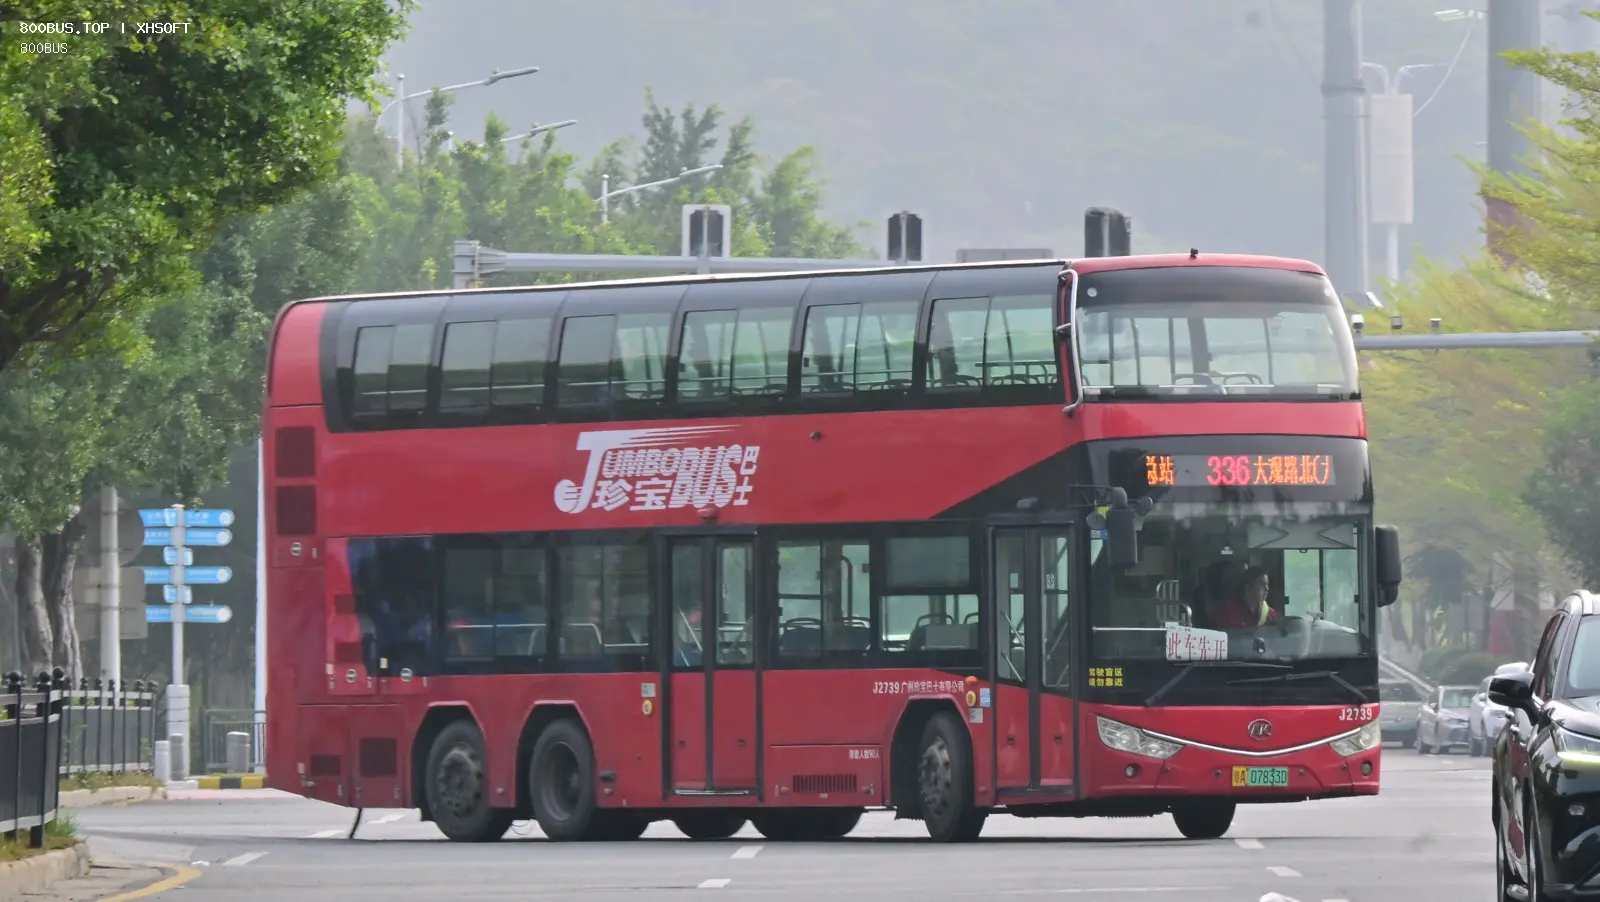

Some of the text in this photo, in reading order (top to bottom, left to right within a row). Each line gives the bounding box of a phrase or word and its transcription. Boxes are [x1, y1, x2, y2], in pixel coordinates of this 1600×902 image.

[1206, 455, 1250, 486] 336
[591, 477, 673, 511] 珍宝
[873, 680, 964, 694] J2739 广州珍宝巴士有限公司
[1339, 707, 1372, 721] J2739
[1250, 770, 1287, 784] 07833D
